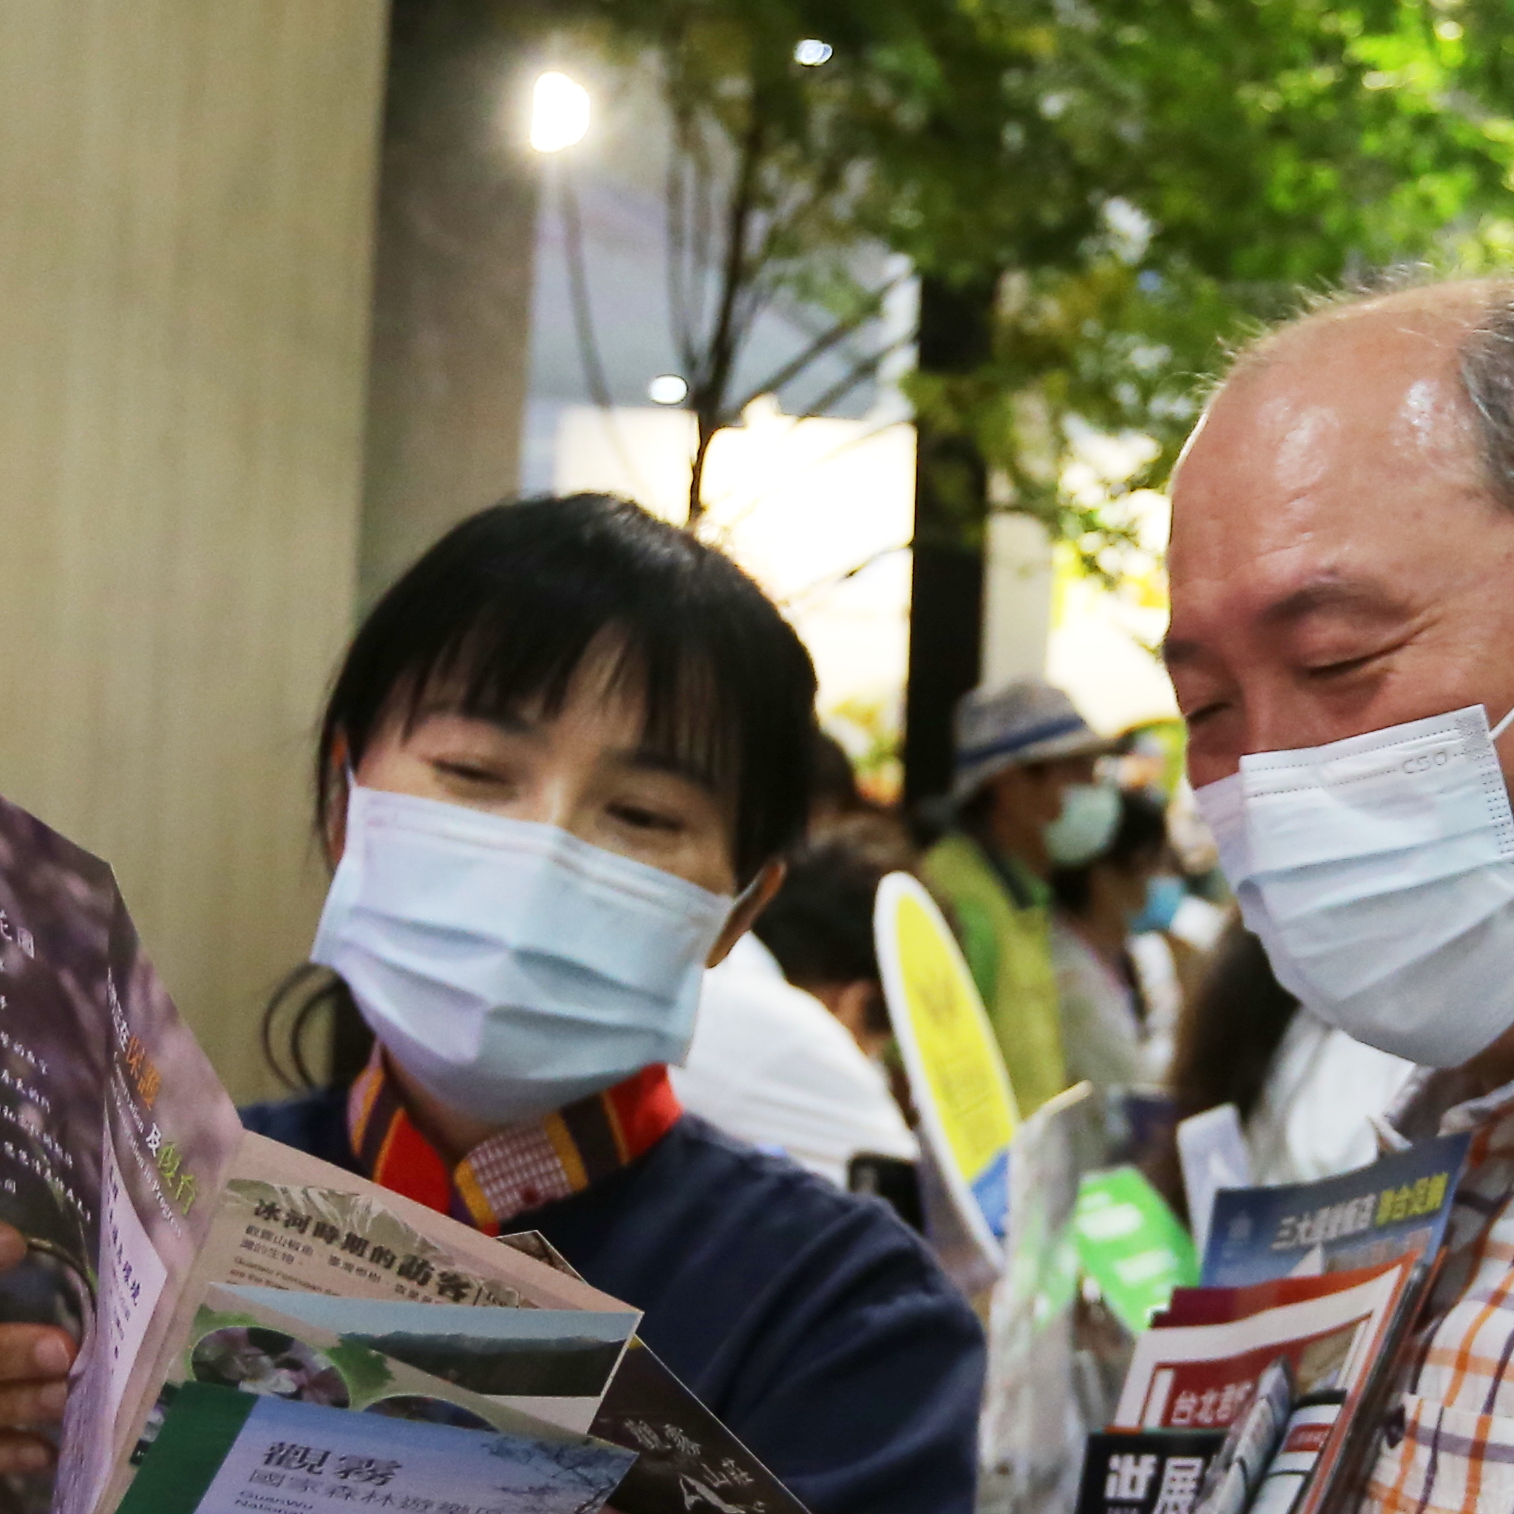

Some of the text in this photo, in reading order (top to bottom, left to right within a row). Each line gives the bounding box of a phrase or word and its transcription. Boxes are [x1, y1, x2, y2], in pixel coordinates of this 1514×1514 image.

[253, 1198, 472, 1303] 冰河時期的訪客
[264, 1441, 403, 1486] 觀霧
